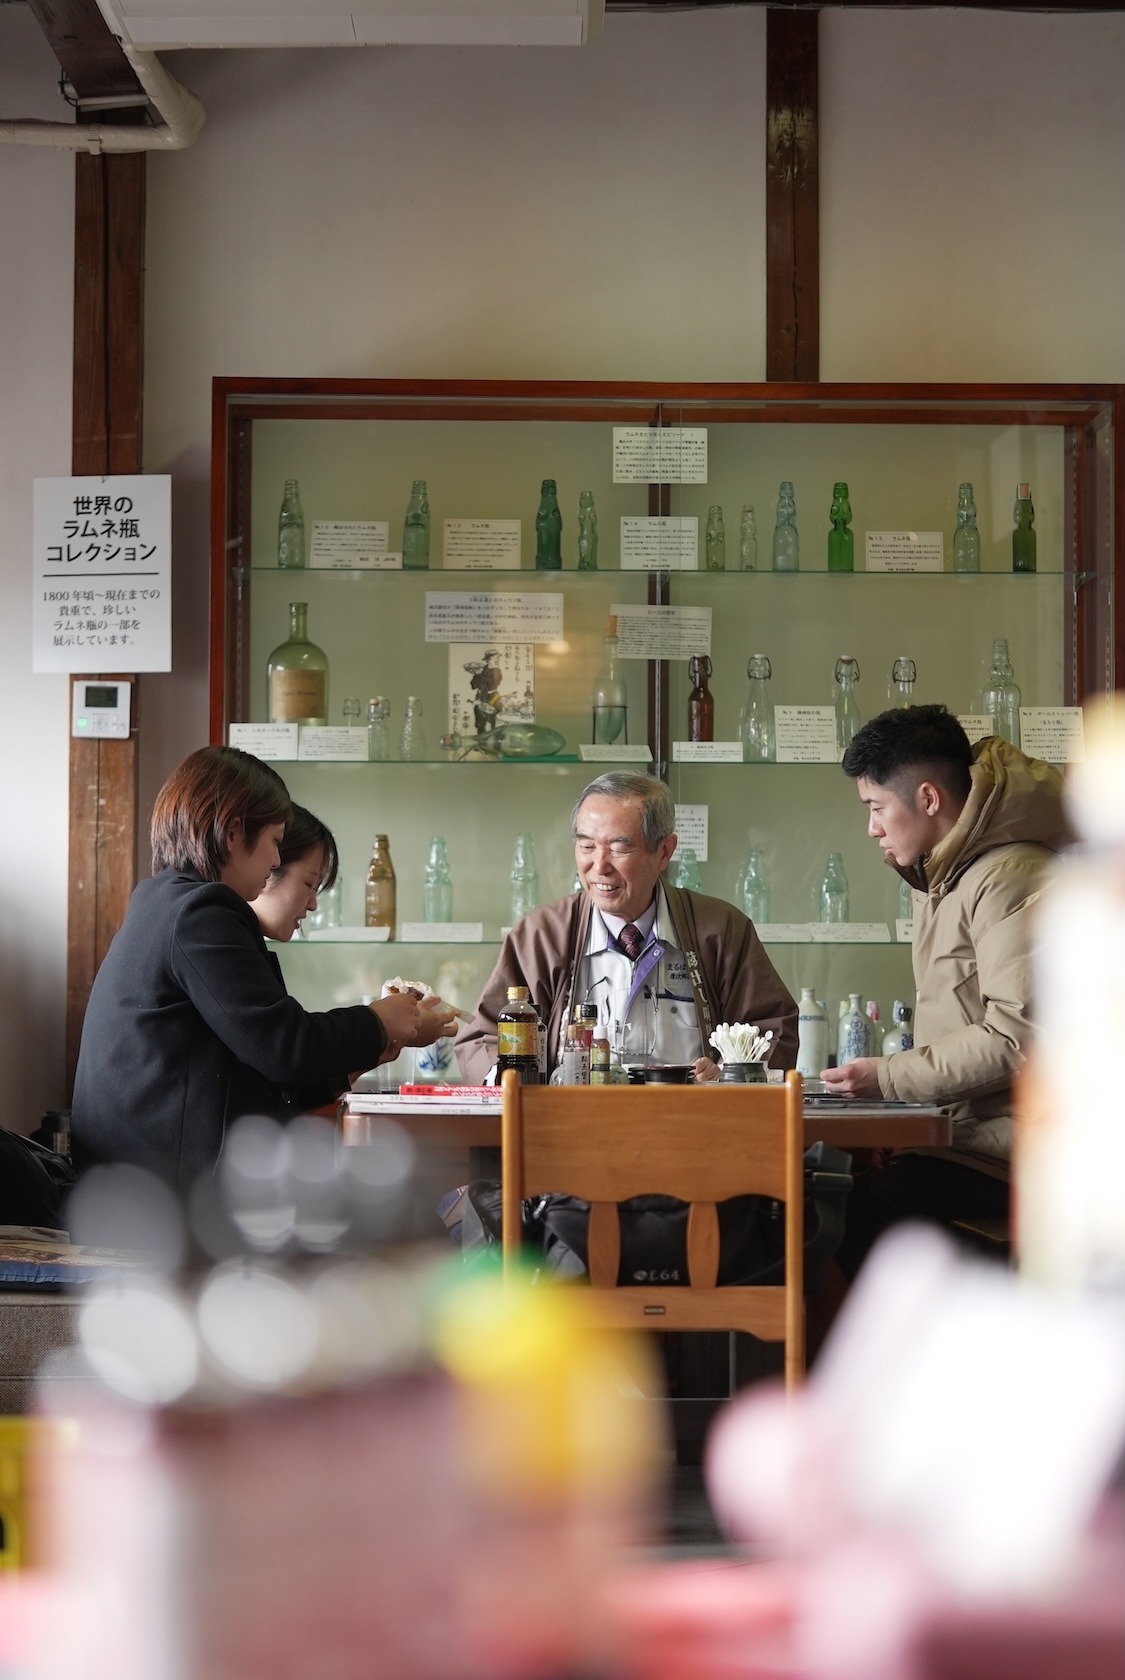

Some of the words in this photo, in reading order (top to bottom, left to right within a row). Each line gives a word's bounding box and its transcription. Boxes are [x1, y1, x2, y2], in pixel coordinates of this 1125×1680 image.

[73, 496, 133, 516] 世界の
[63, 519, 140, 539] ラムネ瓶
[46, 543, 157, 562] コレクション
[59, 605, 136, 616] 貴重で、珍しい
[53, 619, 140, 631] ラムネ瓶の一部を
[53, 635, 136, 647] 展示しています。
